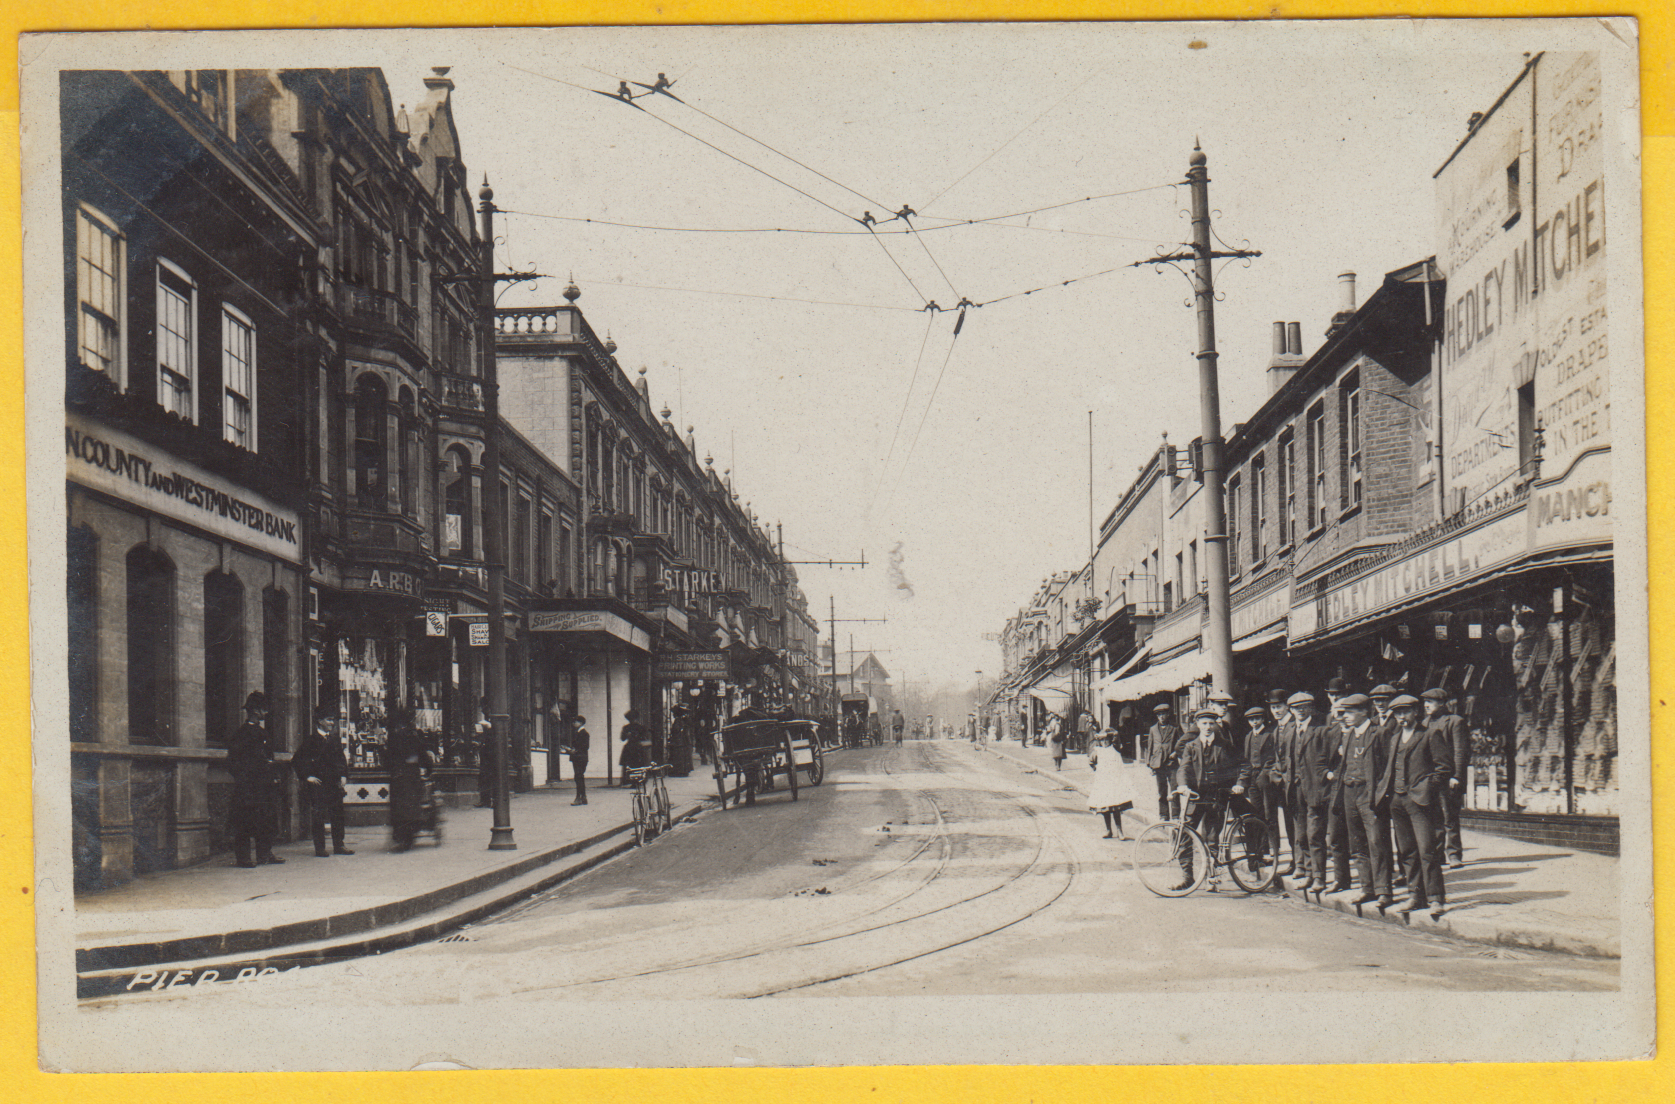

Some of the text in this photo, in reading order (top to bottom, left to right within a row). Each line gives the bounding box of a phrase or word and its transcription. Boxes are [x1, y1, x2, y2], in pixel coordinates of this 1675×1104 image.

[1446, 257, 1506, 367] HEDLEY
[1514, 173, 1607, 314] MTCHE
[1572, 410, 1598, 445] THE
[1450, 421, 1516, 480] DEPARTMENTS
[82, 436, 152, 487] COUNTY
[150, 472, 174, 495] AND
[172, 472, 264, 532] WESTMINSTER
[265, 512, 297, 545] BANK
[664, 569, 727, 593] STARKEY
[427, 613, 445, 634] CIGARS
[531, 613, 571, 629] SHIPPING
[1315, 582, 1370, 630] HEDLEY
[658, 661, 726, 670] PRINTING WORKS
